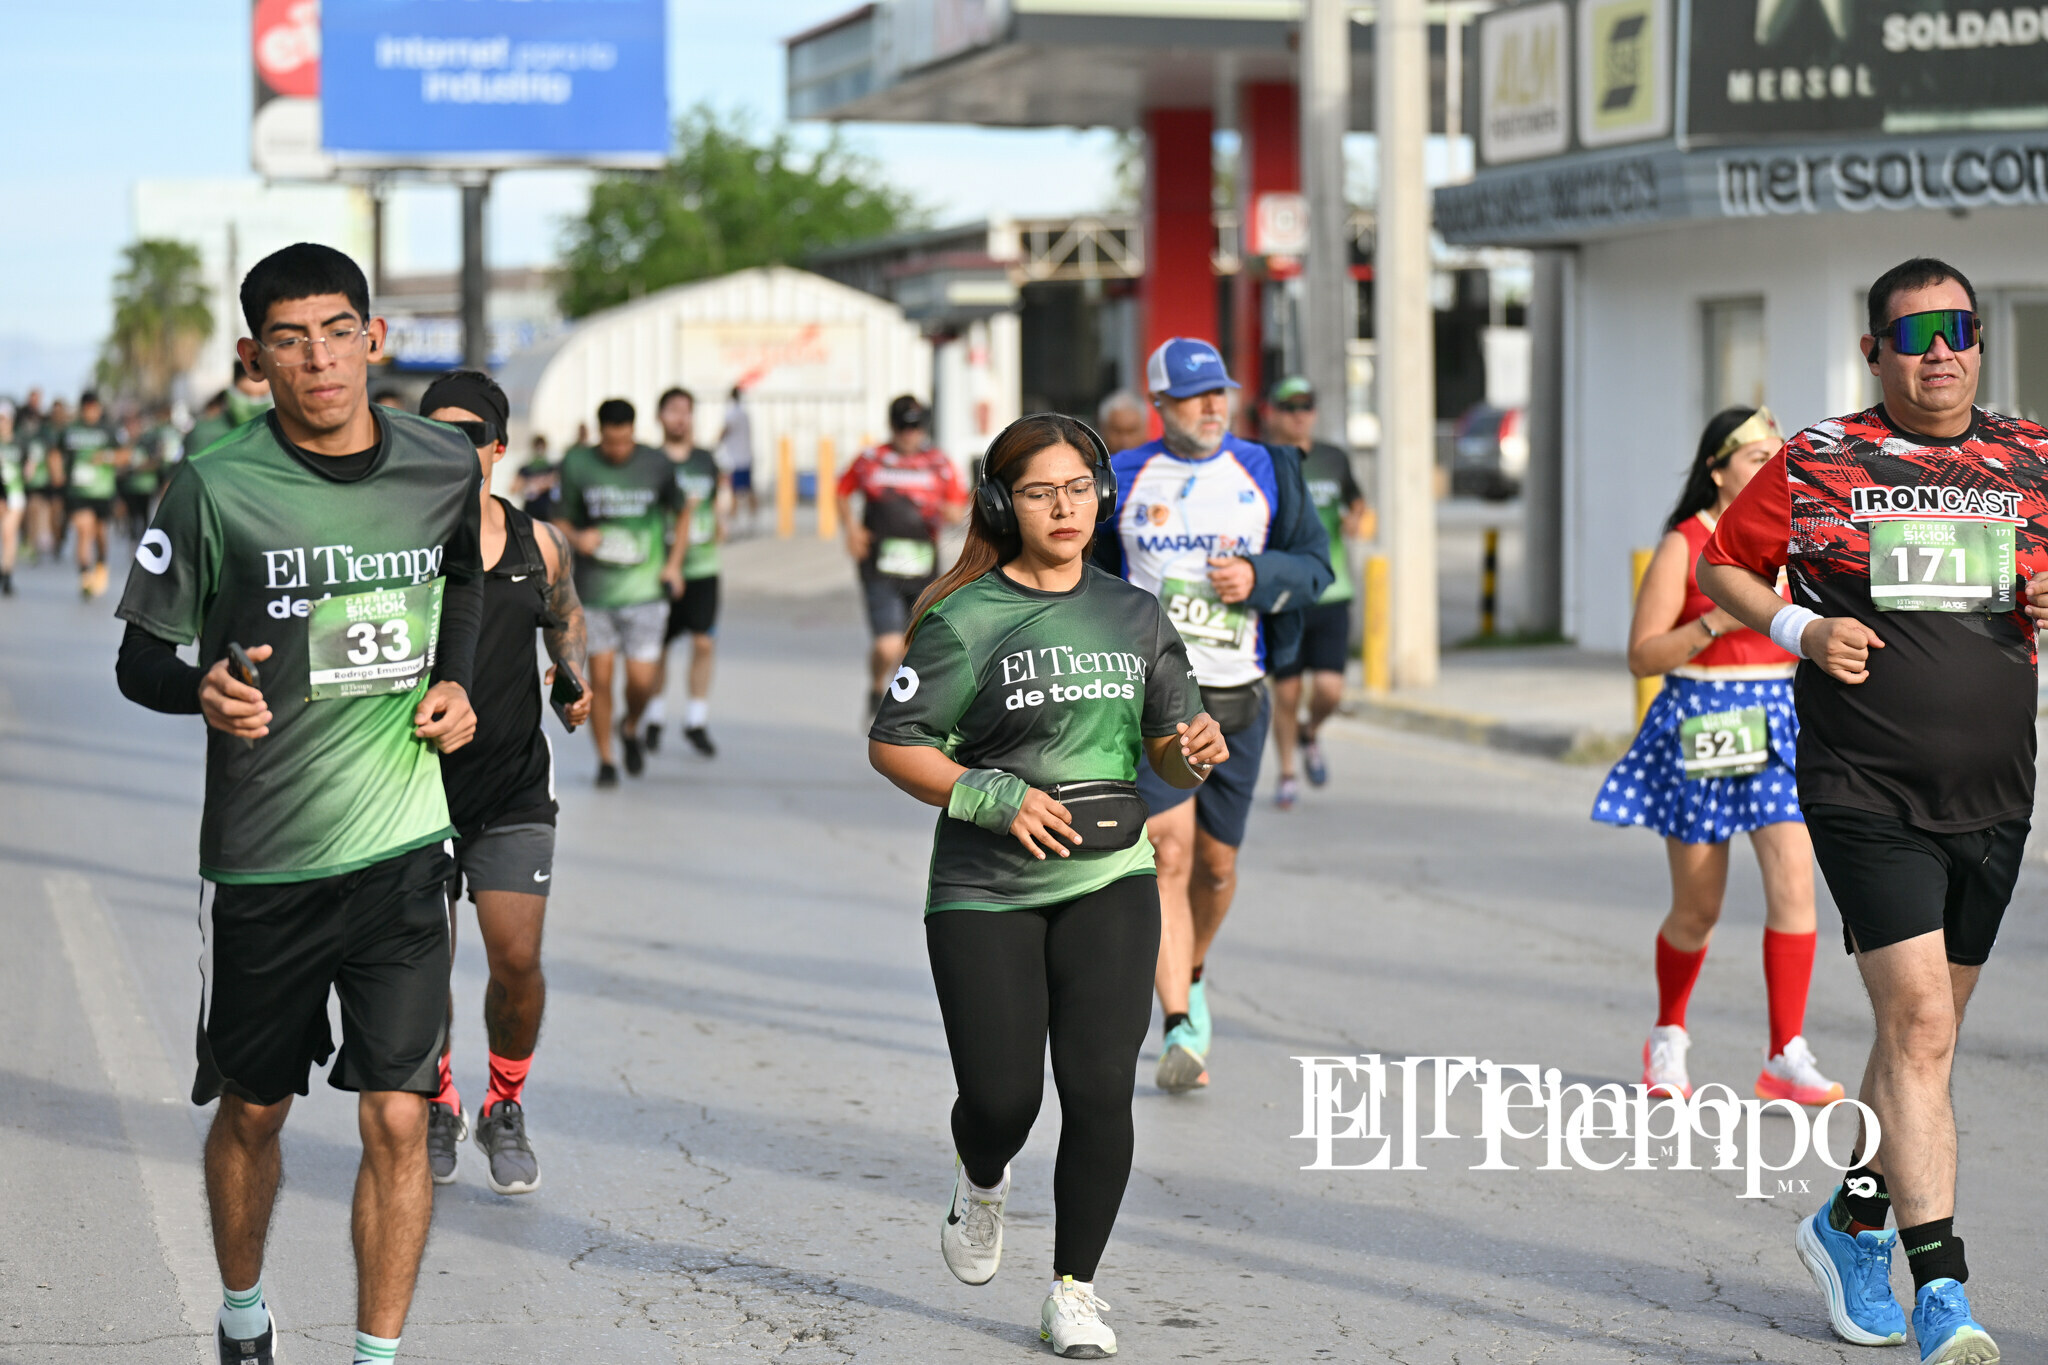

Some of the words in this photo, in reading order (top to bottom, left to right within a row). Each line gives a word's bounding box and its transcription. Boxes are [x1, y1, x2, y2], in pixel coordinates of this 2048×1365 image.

[1727, 63, 1876, 102] MERSOL
[1852, 487, 2022, 518] IRONCAST
[1903, 523, 1956, 532] CARRERA
[1996, 529, 2012, 537] 171
[262, 548, 309, 588] El
[313, 545, 443, 586] Tiempo
[1890, 547, 1966, 583] 171
[1998, 542, 2010, 602] MEDALLA
[267, 595, 311, 619] de
[345, 591, 407, 605] CARRERA
[1167, 594, 1228, 628] 502
[346, 619, 412, 666] 33
[427, 600, 440, 667] MEDALLA
[334, 670, 374, 680] Rodrigo
[999, 650, 1039, 686] El
[1040, 645, 1147, 681] Tiempo
[1005, 688, 1045, 711] de
[1049, 679, 1135, 704] todos
[1695, 727, 1753, 759] 521
